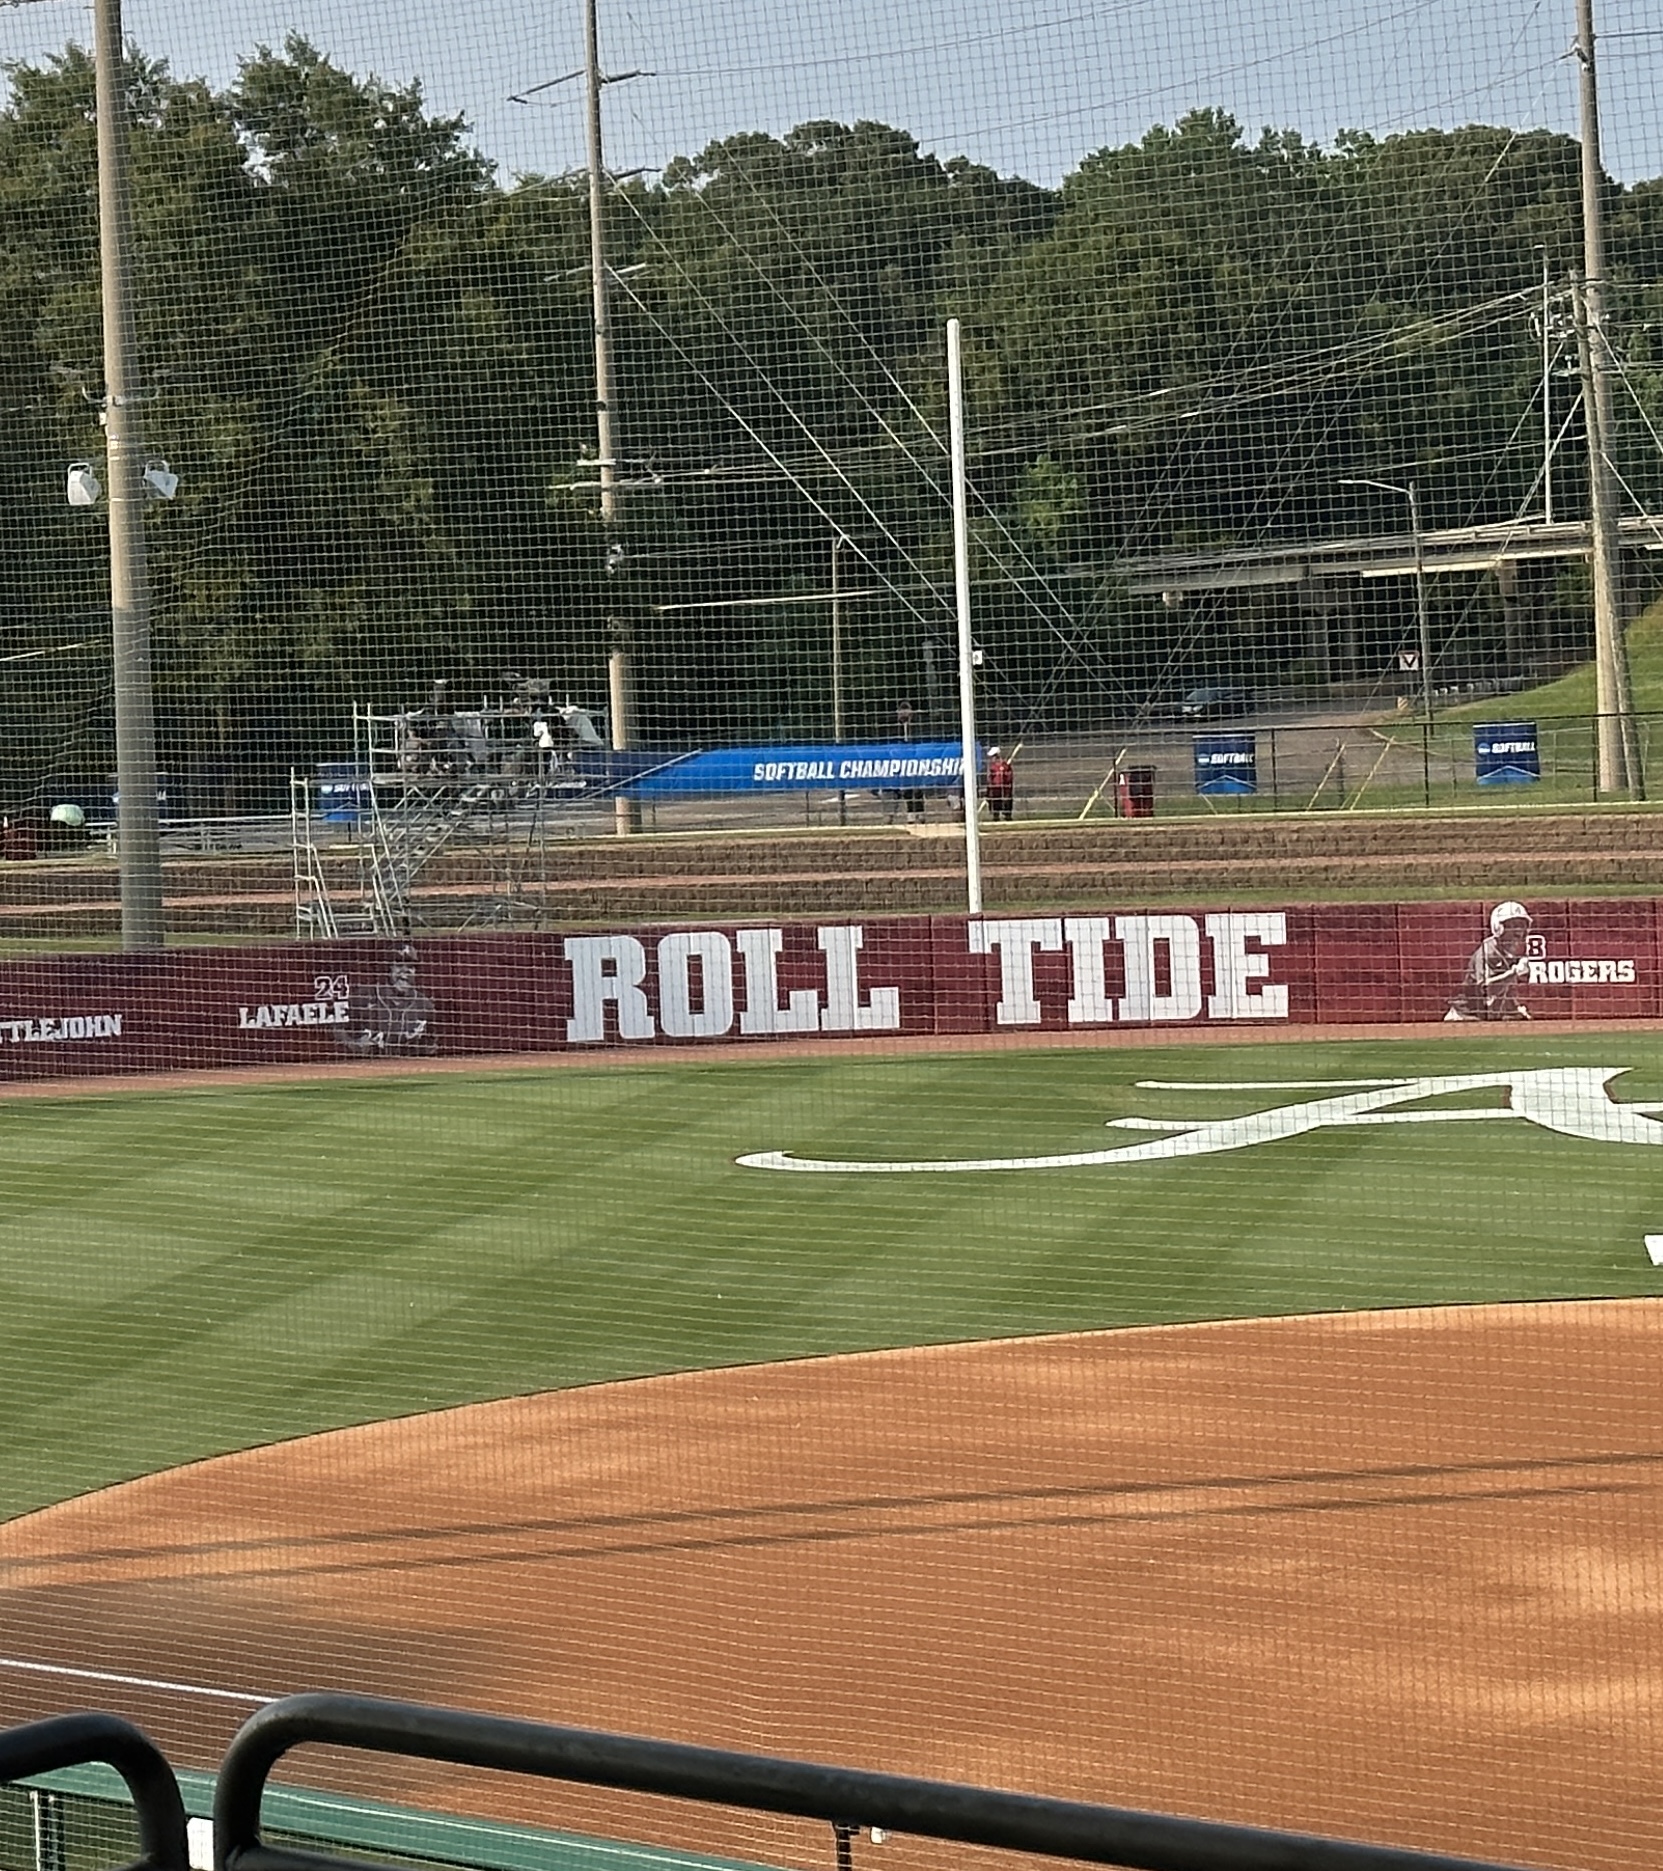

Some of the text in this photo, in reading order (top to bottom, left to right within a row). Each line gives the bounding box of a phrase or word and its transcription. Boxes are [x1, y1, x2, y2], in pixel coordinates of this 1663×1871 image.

[753, 760, 836, 781] SOFTBALL
[1526, 934, 1546, 961] 8
[564, 912, 1289, 1043] ROLL TIDE
[1528, 959, 1636, 984] ROGERS
[314, 975, 350, 1001] 24
[238, 1001, 350, 1029] LAFAELE
